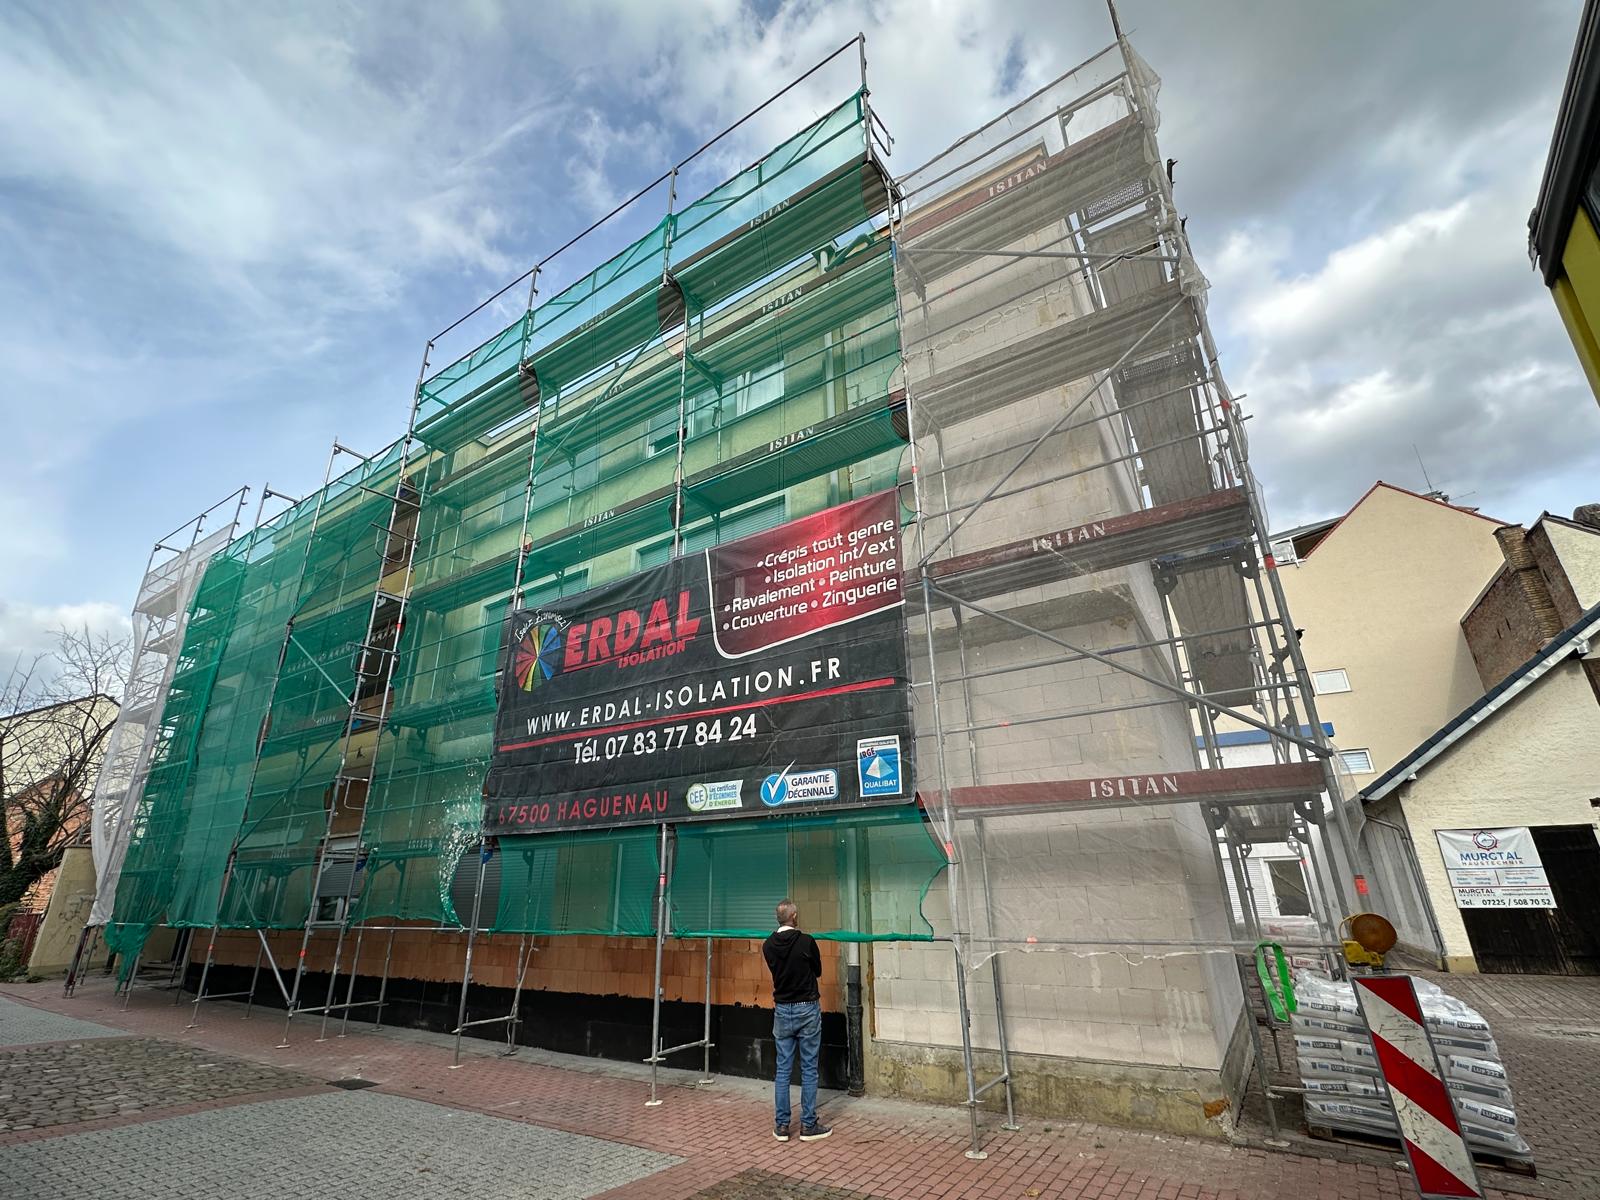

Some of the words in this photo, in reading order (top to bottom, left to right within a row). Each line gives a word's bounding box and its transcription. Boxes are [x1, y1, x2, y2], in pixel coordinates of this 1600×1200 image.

[988, 160, 1047, 197] ISITAN
[749, 199, 790, 228] ISITAN
[762, 287, 802, 314] ISITAN
[769, 425, 814, 452] ISITAN
[584, 509, 615, 528] ISITAN
[765, 546, 808, 568] Crépis
[812, 532, 843, 554] tout
[847, 519, 894, 543] genre
[1032, 521, 1106, 552] ISITAN
[773, 556, 835, 583] Isolation
[839, 536, 896, 564] int/ext
[732, 578, 815, 613] Ravalement
[829, 558, 897, 586] Peinture
[731, 601, 808, 631] Couverture
[822, 577, 898, 607] Zinguerie
[563, 591, 701, 668] ERDAL
[618, 640, 687, 668] ISOLATION
[527, 657, 841, 735] WWW.ERDAL-ISOLATION.FR
[574, 738, 600, 764] Tél.
[605, 735, 628, 760] 07
[633, 730, 657, 755] 83
[663, 725, 688, 751] 77
[695, 719, 722, 746] 84
[728, 713, 757, 742] 24
[861, 747, 876, 759] RGE
[788, 786, 834, 799] DÉCENNALE
[791, 773, 830, 787] GARANTIE
[864, 780, 897, 788] QUALIBAT
[1089, 775, 1178, 798] ISITAN
[499, 803, 550, 825] 67500
[557, 790, 668, 821] HAGUENAU
[690, 789, 704, 804] CEE
[1460, 851, 1523, 861] MURGTAL
[1542, 898, 1551, 906] 52
